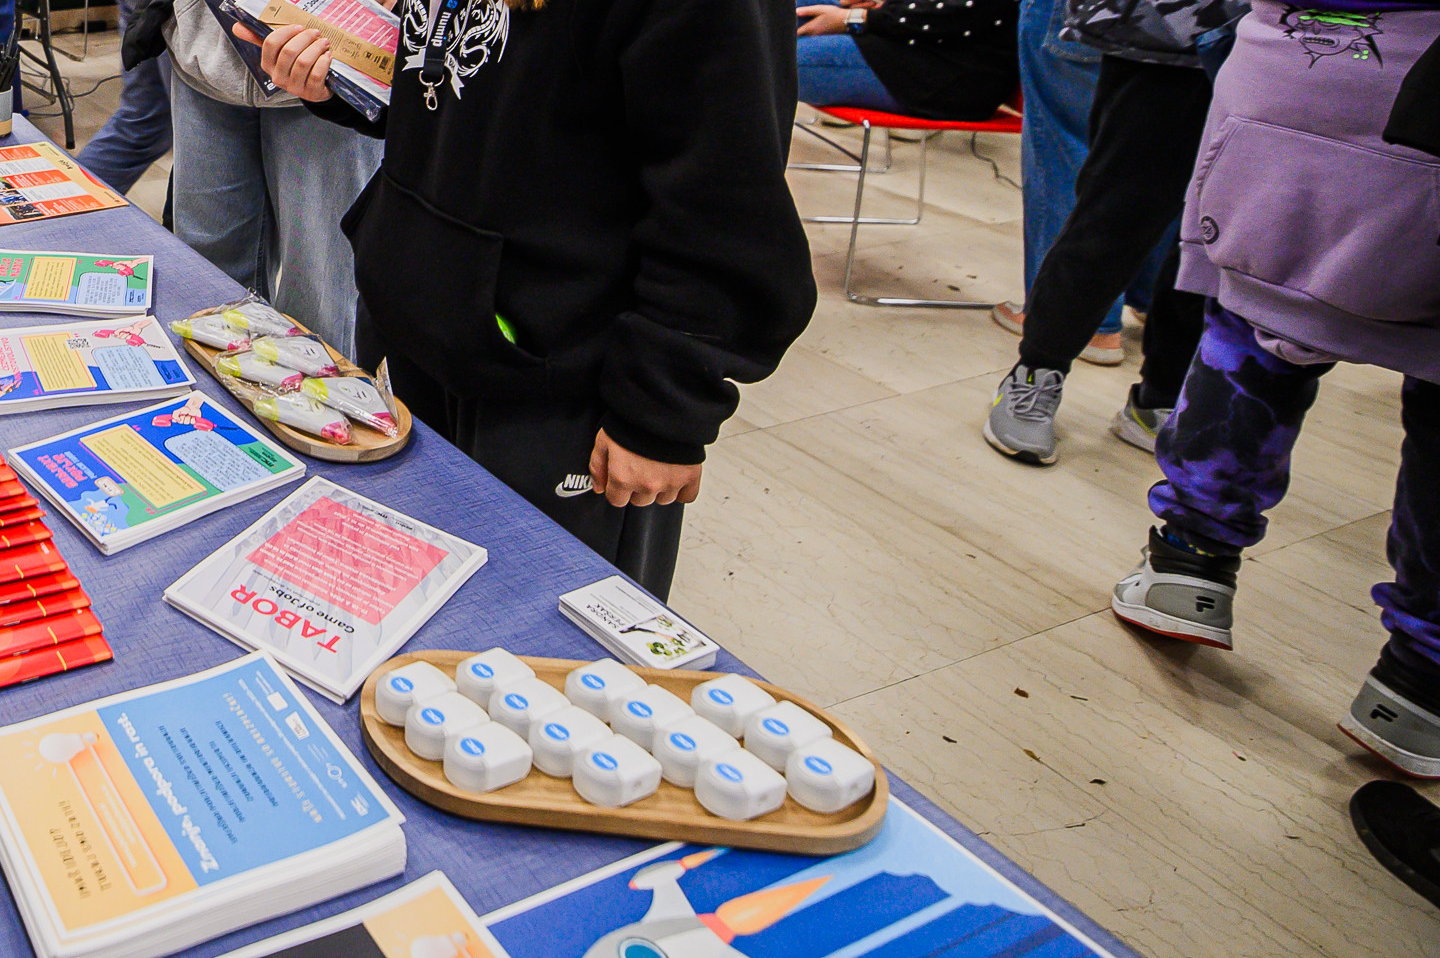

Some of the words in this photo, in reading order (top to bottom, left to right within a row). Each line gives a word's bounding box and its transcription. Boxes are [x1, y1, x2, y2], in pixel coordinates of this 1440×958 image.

[432, 11, 451, 47] numip
[268, 585, 300, 606] Jobs
[297, 603, 315, 613] of
[229, 583, 343, 655] TABOR
[316, 610, 356, 635] Game
[114, 712, 141, 745] rast.
[132, 741, 149, 760] in
[140, 755, 189, 819] podpora
[175, 812, 221, 876] Znanje,
